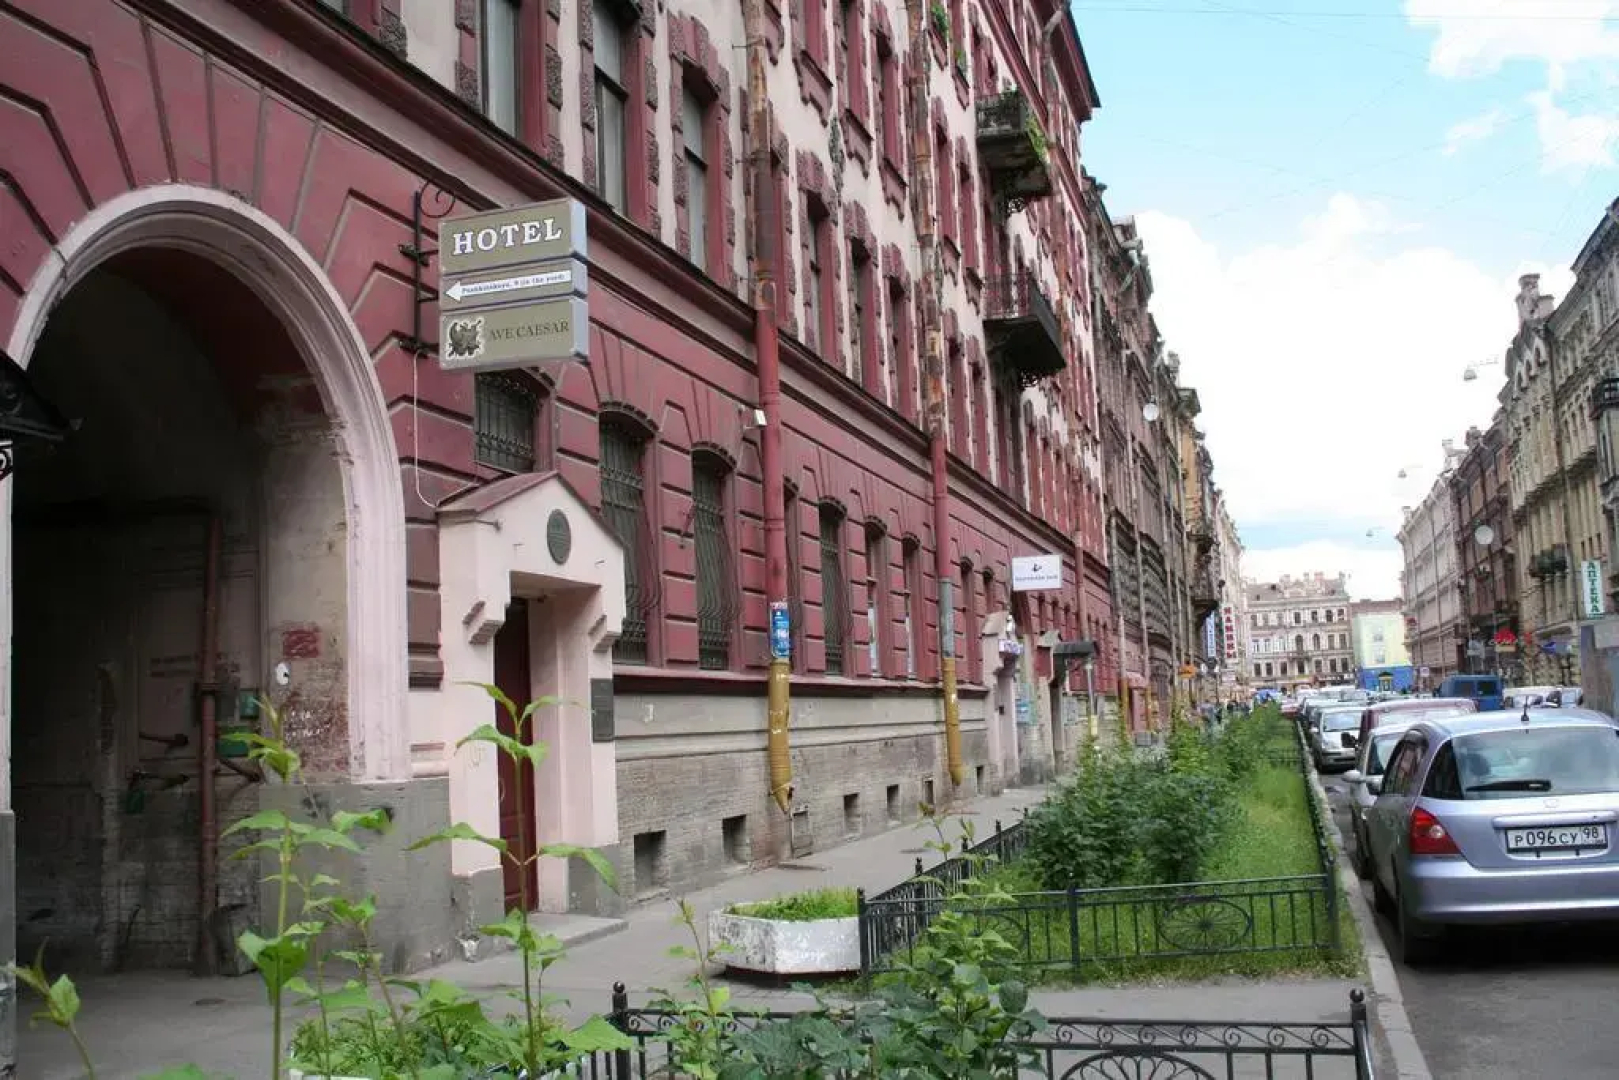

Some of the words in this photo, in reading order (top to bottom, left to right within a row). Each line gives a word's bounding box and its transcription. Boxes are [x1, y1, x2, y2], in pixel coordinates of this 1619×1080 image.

[453, 218, 562, 255] HOTEL
[489, 328, 513, 341] AVE
[516, 320, 570, 338] CAESAR
[1587, 562, 1600, 613] АПТЕКА
